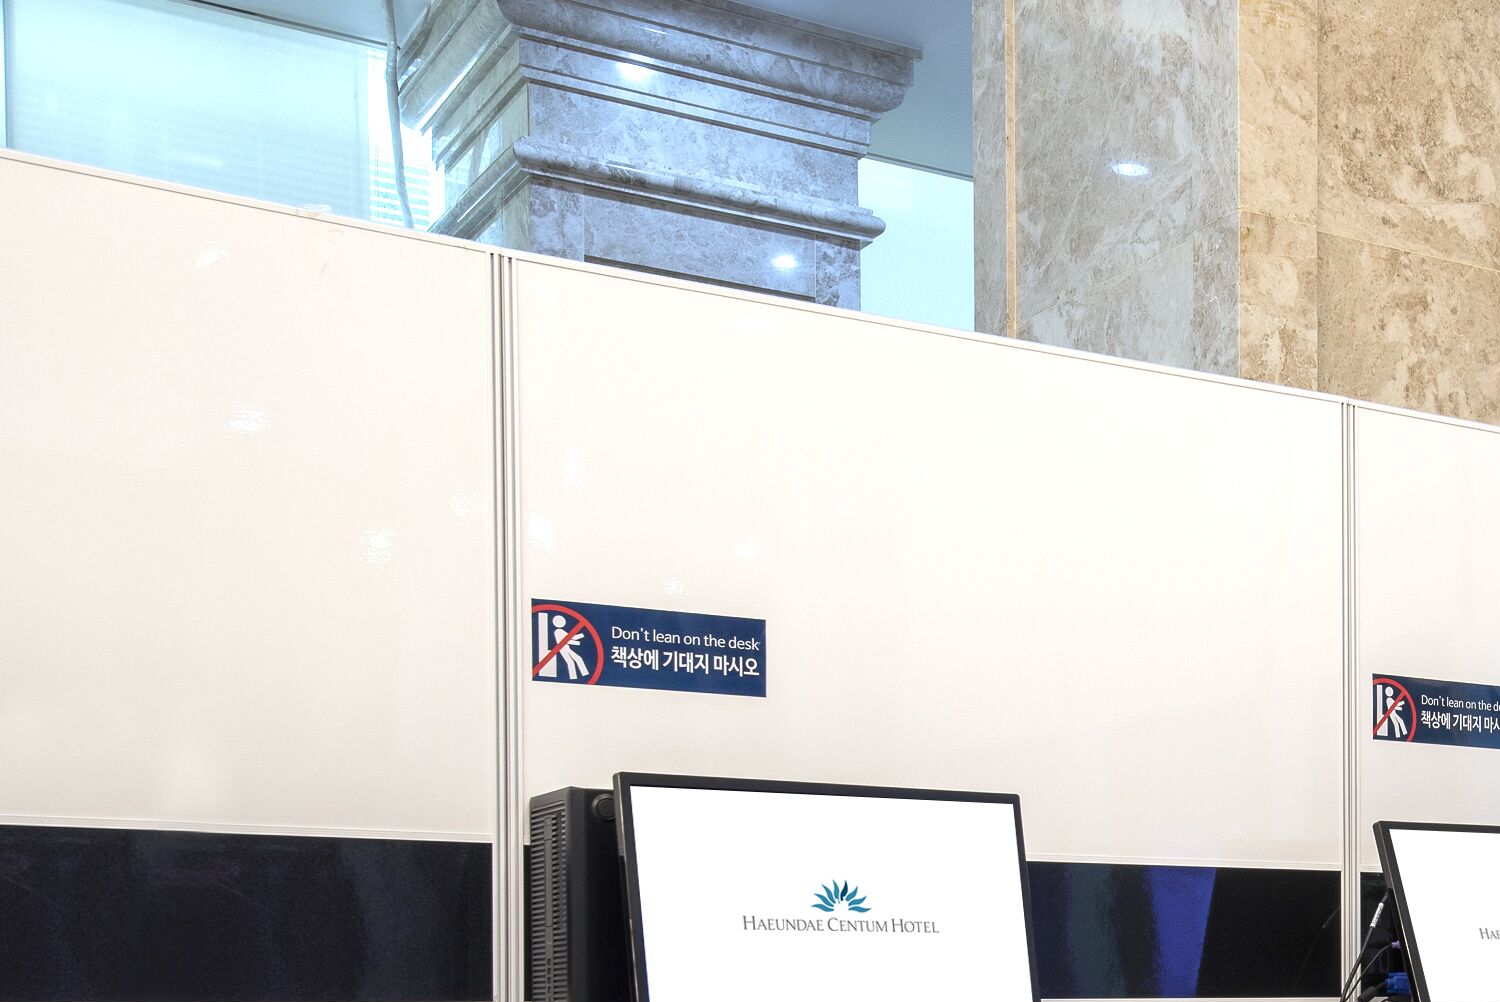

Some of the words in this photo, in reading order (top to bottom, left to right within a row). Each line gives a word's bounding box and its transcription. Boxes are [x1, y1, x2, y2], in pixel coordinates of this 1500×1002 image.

[611, 626, 650, 642] Don't
[653, 629, 680, 644] lean
[683, 634, 701, 646] on
[704, 633, 726, 648] the
[728, 636, 760, 651] desk
[611, 646, 659, 671] 책상에
[663, 651, 709, 675] 기대지
[713, 655, 760, 677] 마시오
[1421, 694, 1445, 707] Don't
[1446, 696, 1464, 709] lean
[1465, 700, 1477, 710] on
[1478, 699, 1492, 711] the
[1421, 710, 1451, 730] 책상에
[1452, 713, 1482, 733] 기대지
[743, 915, 825, 932] HAEUNDAE
[827, 917, 889, 933] CENTUM
[891, 918, 940, 934] HOTEL
